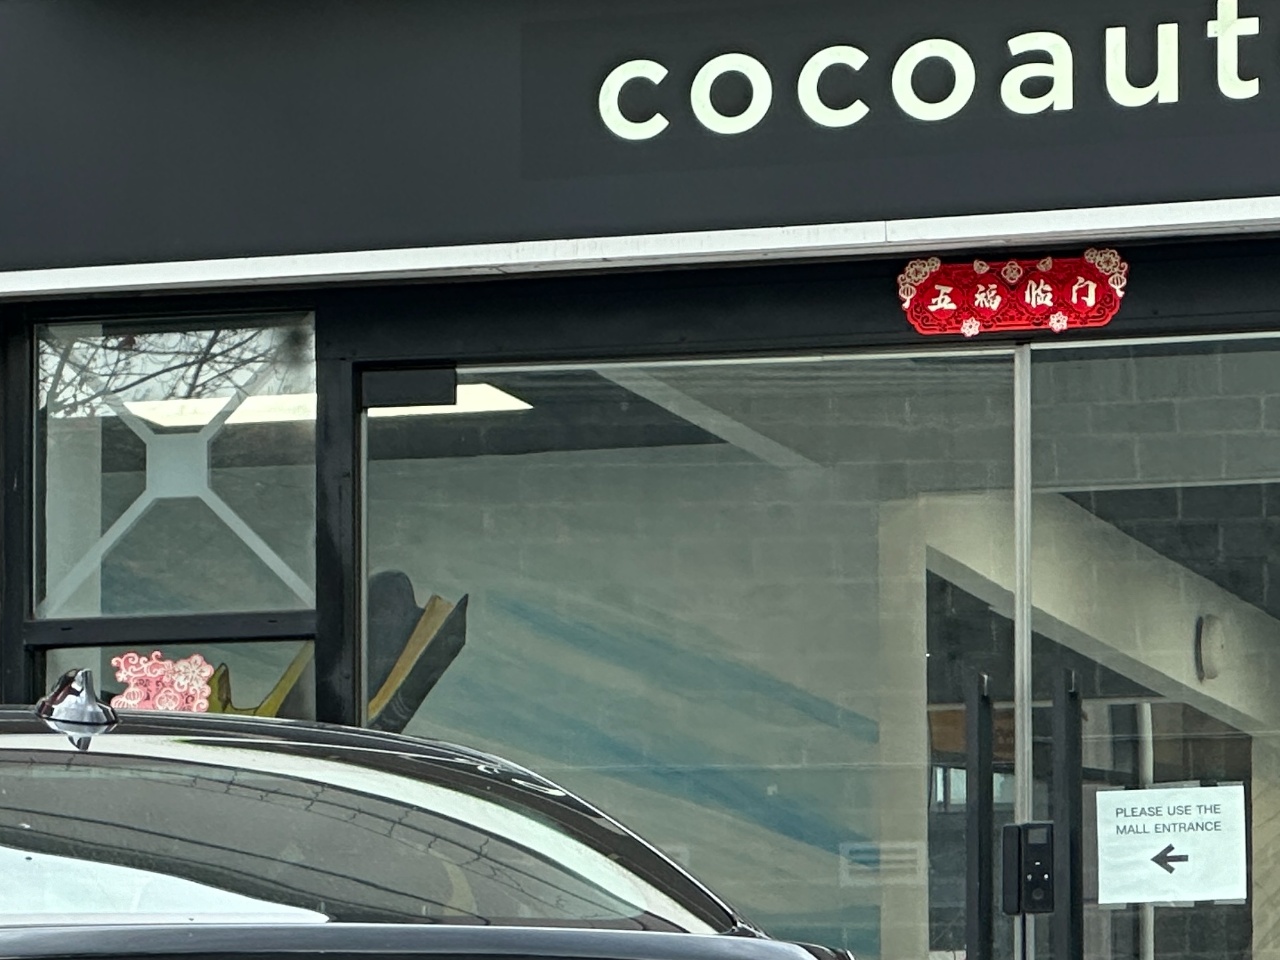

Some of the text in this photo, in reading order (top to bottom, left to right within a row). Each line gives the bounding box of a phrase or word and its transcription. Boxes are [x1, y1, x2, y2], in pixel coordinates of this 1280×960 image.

[927, 275, 1098, 312] 五福临门
[1116, 804, 1221, 817] PLEASE USE THE
[1116, 821, 1221, 835] MALL ENTRANCE
